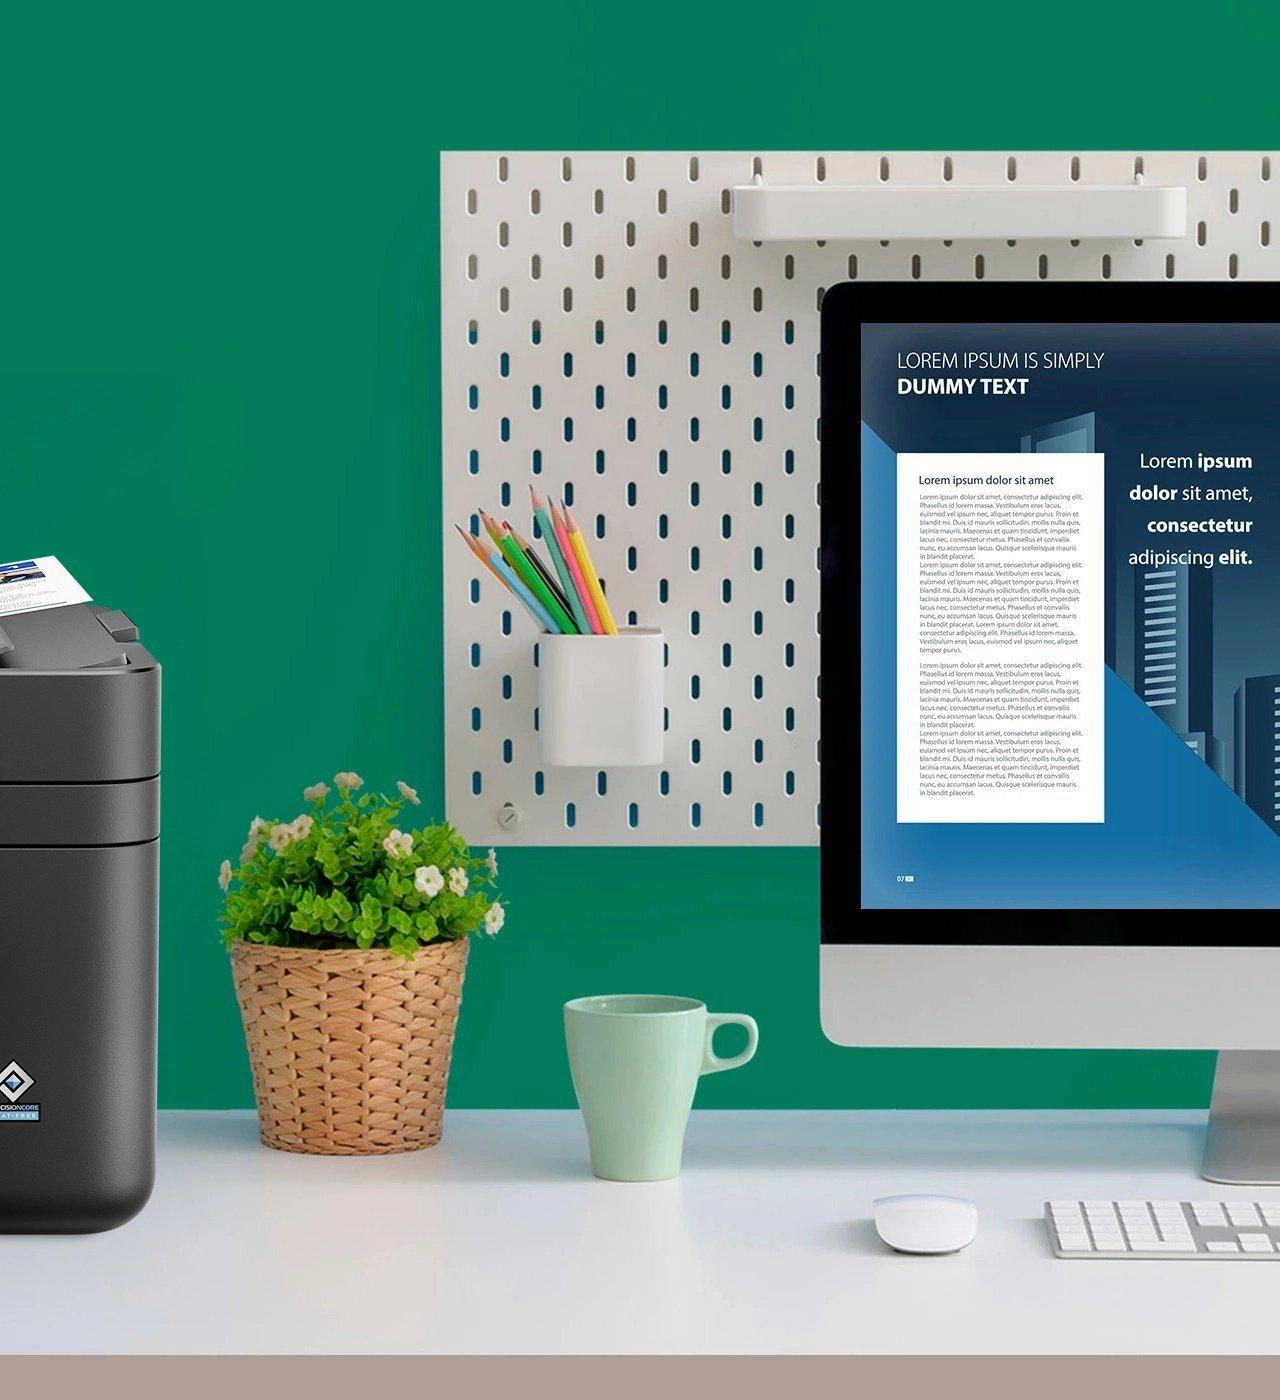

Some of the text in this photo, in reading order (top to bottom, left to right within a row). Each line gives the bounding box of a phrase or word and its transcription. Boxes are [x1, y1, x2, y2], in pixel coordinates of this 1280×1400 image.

[898, 352, 1104, 369] LOREM IPSUM IS SIMPLY
[898, 378, 1029, 394] DUMMY TEXT
[1140, 453, 1252, 472] Lorem ipsum
[919, 475, 1054, 487] Lorem ipsum dolor sit amet
[1130, 485, 1252, 502] dolor sit amet,
[1147, 519, 1253, 533] consectetur
[1128, 549, 1252, 569] adipiscing elit.
